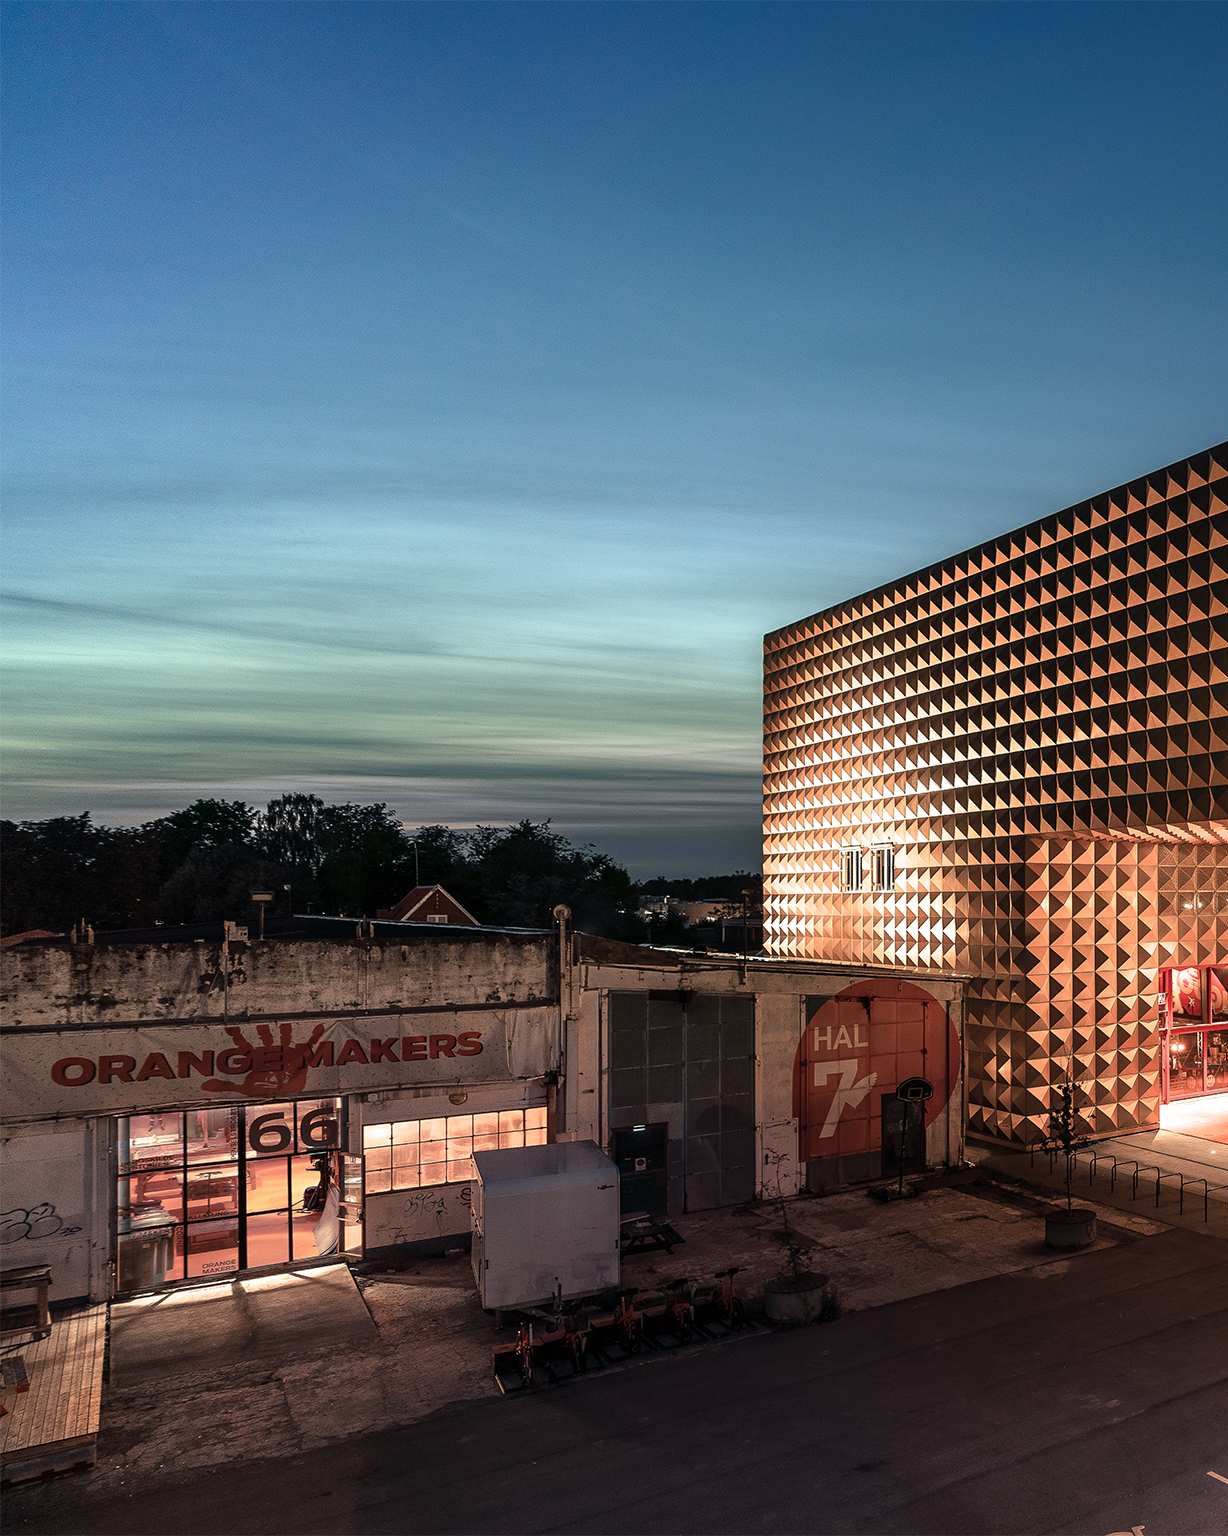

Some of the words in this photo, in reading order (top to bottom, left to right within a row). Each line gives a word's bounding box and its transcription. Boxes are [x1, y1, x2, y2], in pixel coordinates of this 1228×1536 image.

[813, 1023, 869, 1052] HAL
[51, 1044, 287, 1087] ORANGE
[299, 1031, 486, 1069] MAKERS
[813, 1058, 862, 1140] 7
[248, 1106, 339, 1154] 66
[202, 1258, 237, 1269] ORANGE
[202, 1264, 237, 1275] MAKERS
